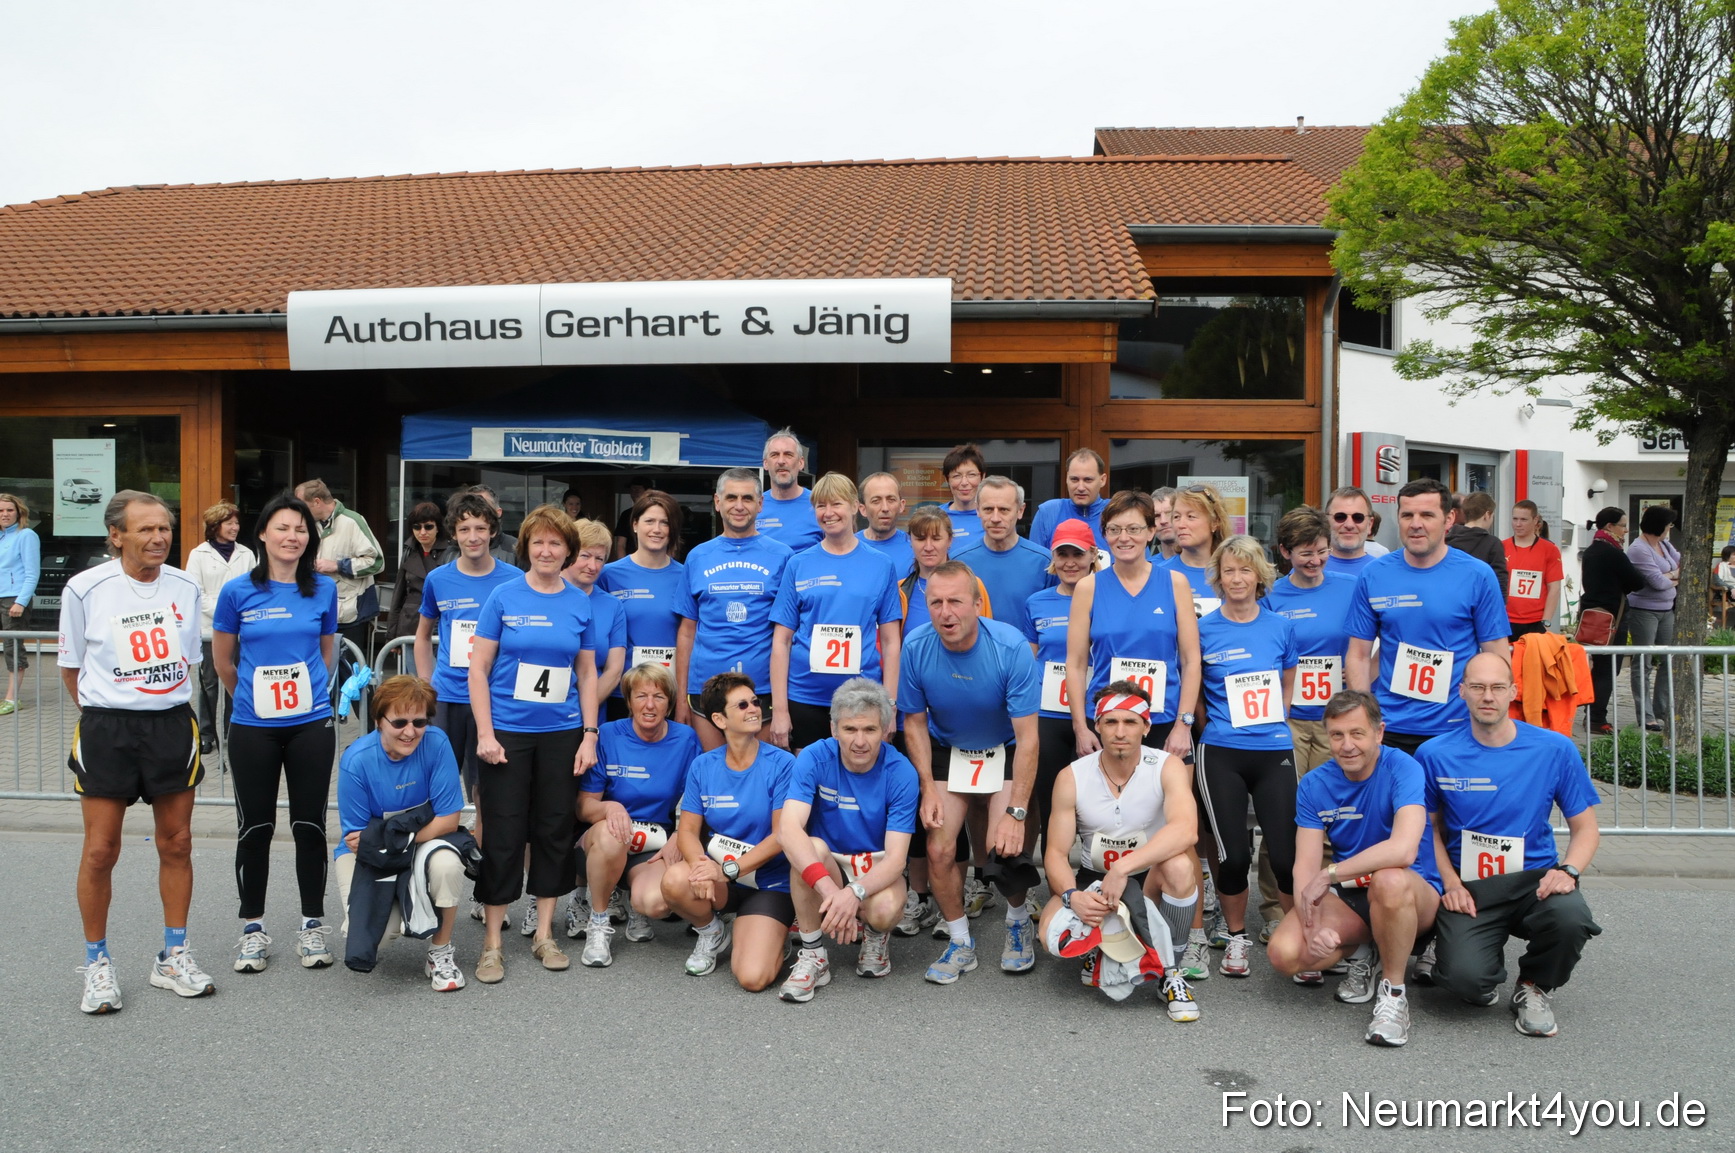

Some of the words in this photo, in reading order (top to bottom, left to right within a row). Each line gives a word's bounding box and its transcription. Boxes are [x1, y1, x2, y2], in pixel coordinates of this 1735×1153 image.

[324, 312, 523, 344] Autohaus
[545, 307, 722, 338] Gerhart
[740, 306, 775, 336] &
[793, 304, 911, 344] Jänig
[511, 436, 587, 454] Neumarkter
[588, 438, 644, 457] Tagblatt
[1371, 494, 1397, 504] SEA
[703, 561, 770, 578] funrunners
[1517, 578, 1535, 596] 57
[121, 613, 151, 625] MEYER
[123, 620, 153, 630] WERBUNG
[129, 627, 170, 663] 86
[825, 639, 851, 668] 21
[1406, 648, 1432, 660] MEYER
[1406, 654, 1432, 664] WERBUNG
[1121, 660, 1147, 668] MEYER
[533, 669, 550, 698] 4
[1235, 674, 1261, 684] MEYER
[1235, 680, 1262, 688] WERBUNG
[1301, 672, 1332, 701] 55
[1408, 663, 1436, 695] 16
[270, 680, 299, 711] 13
[1242, 688, 1270, 720] 67
[970, 760, 984, 786] 7
[719, 838, 742, 851] MEYER
[1100, 837, 1126, 846] MEYER
[1471, 834, 1499, 845] MEYER
[1471, 841, 1499, 850] WERBUNG
[1103, 849, 1134, 871] 8
[1478, 852, 1505, 879] 61
